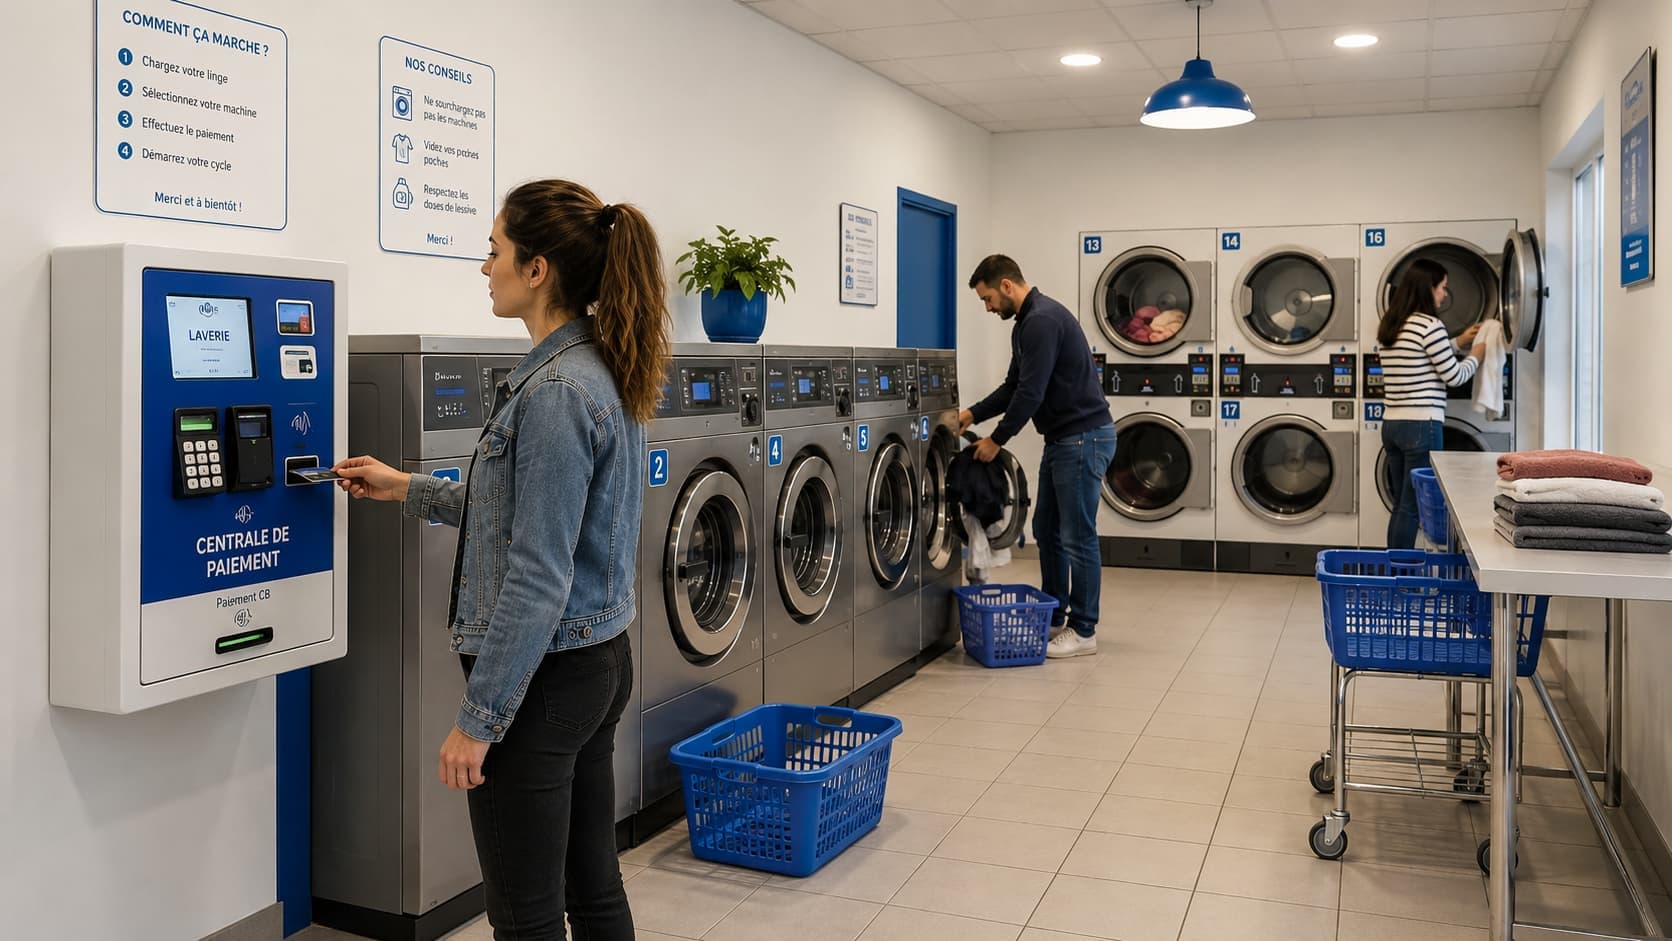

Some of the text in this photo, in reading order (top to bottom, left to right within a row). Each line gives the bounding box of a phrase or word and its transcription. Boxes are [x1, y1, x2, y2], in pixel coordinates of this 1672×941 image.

[122, 9, 270, 57] COMMENT ÇA MARCHE ?
[122, 51, 229, 85] 1 Chargez votre linge
[405, 56, 472, 84] NOS CONSEILS
[121, 82, 257, 118] 2 Sélectionnez votre machine
[424, 95, 434, 106] Ne
[475, 109, 486, 119] pas
[424, 112, 436, 121] pas
[437, 112, 447, 123] les
[121, 113, 235, 143] 3 Effectuez le paiement
[424, 140, 443, 153] Videz
[443, 147, 456, 155] vos
[120, 145, 232, 172] 4 Démarrez votre cycle
[424, 156, 449, 168] poches
[424, 184, 469, 200] Respectez les
[154, 191, 182, 205] Merci
[184, 197, 194, 206] et
[196, 198, 202, 207] à
[239, 203, 242, 212] !
[424, 200, 444, 211] doses
[444, 203, 454, 212] de
[427, 233, 453, 245] Merci !
[1086, 239, 1099, 251] 13
[1224, 236, 1238, 247] 14
[1367, 231, 1383, 243] 16
[189, 330, 230, 341] LAVERIE
[1223, 404, 1238, 417] 17
[1367, 405, 1382, 418] 18
[861, 430, 866, 446] 5
[771, 441, 779, 459] 4
[654, 456, 663, 479] 2
[196, 526, 289, 554] CENTRALE DE
[207, 550, 280, 577] PAIEMENT
[216, 588, 271, 608] Paiement CB
